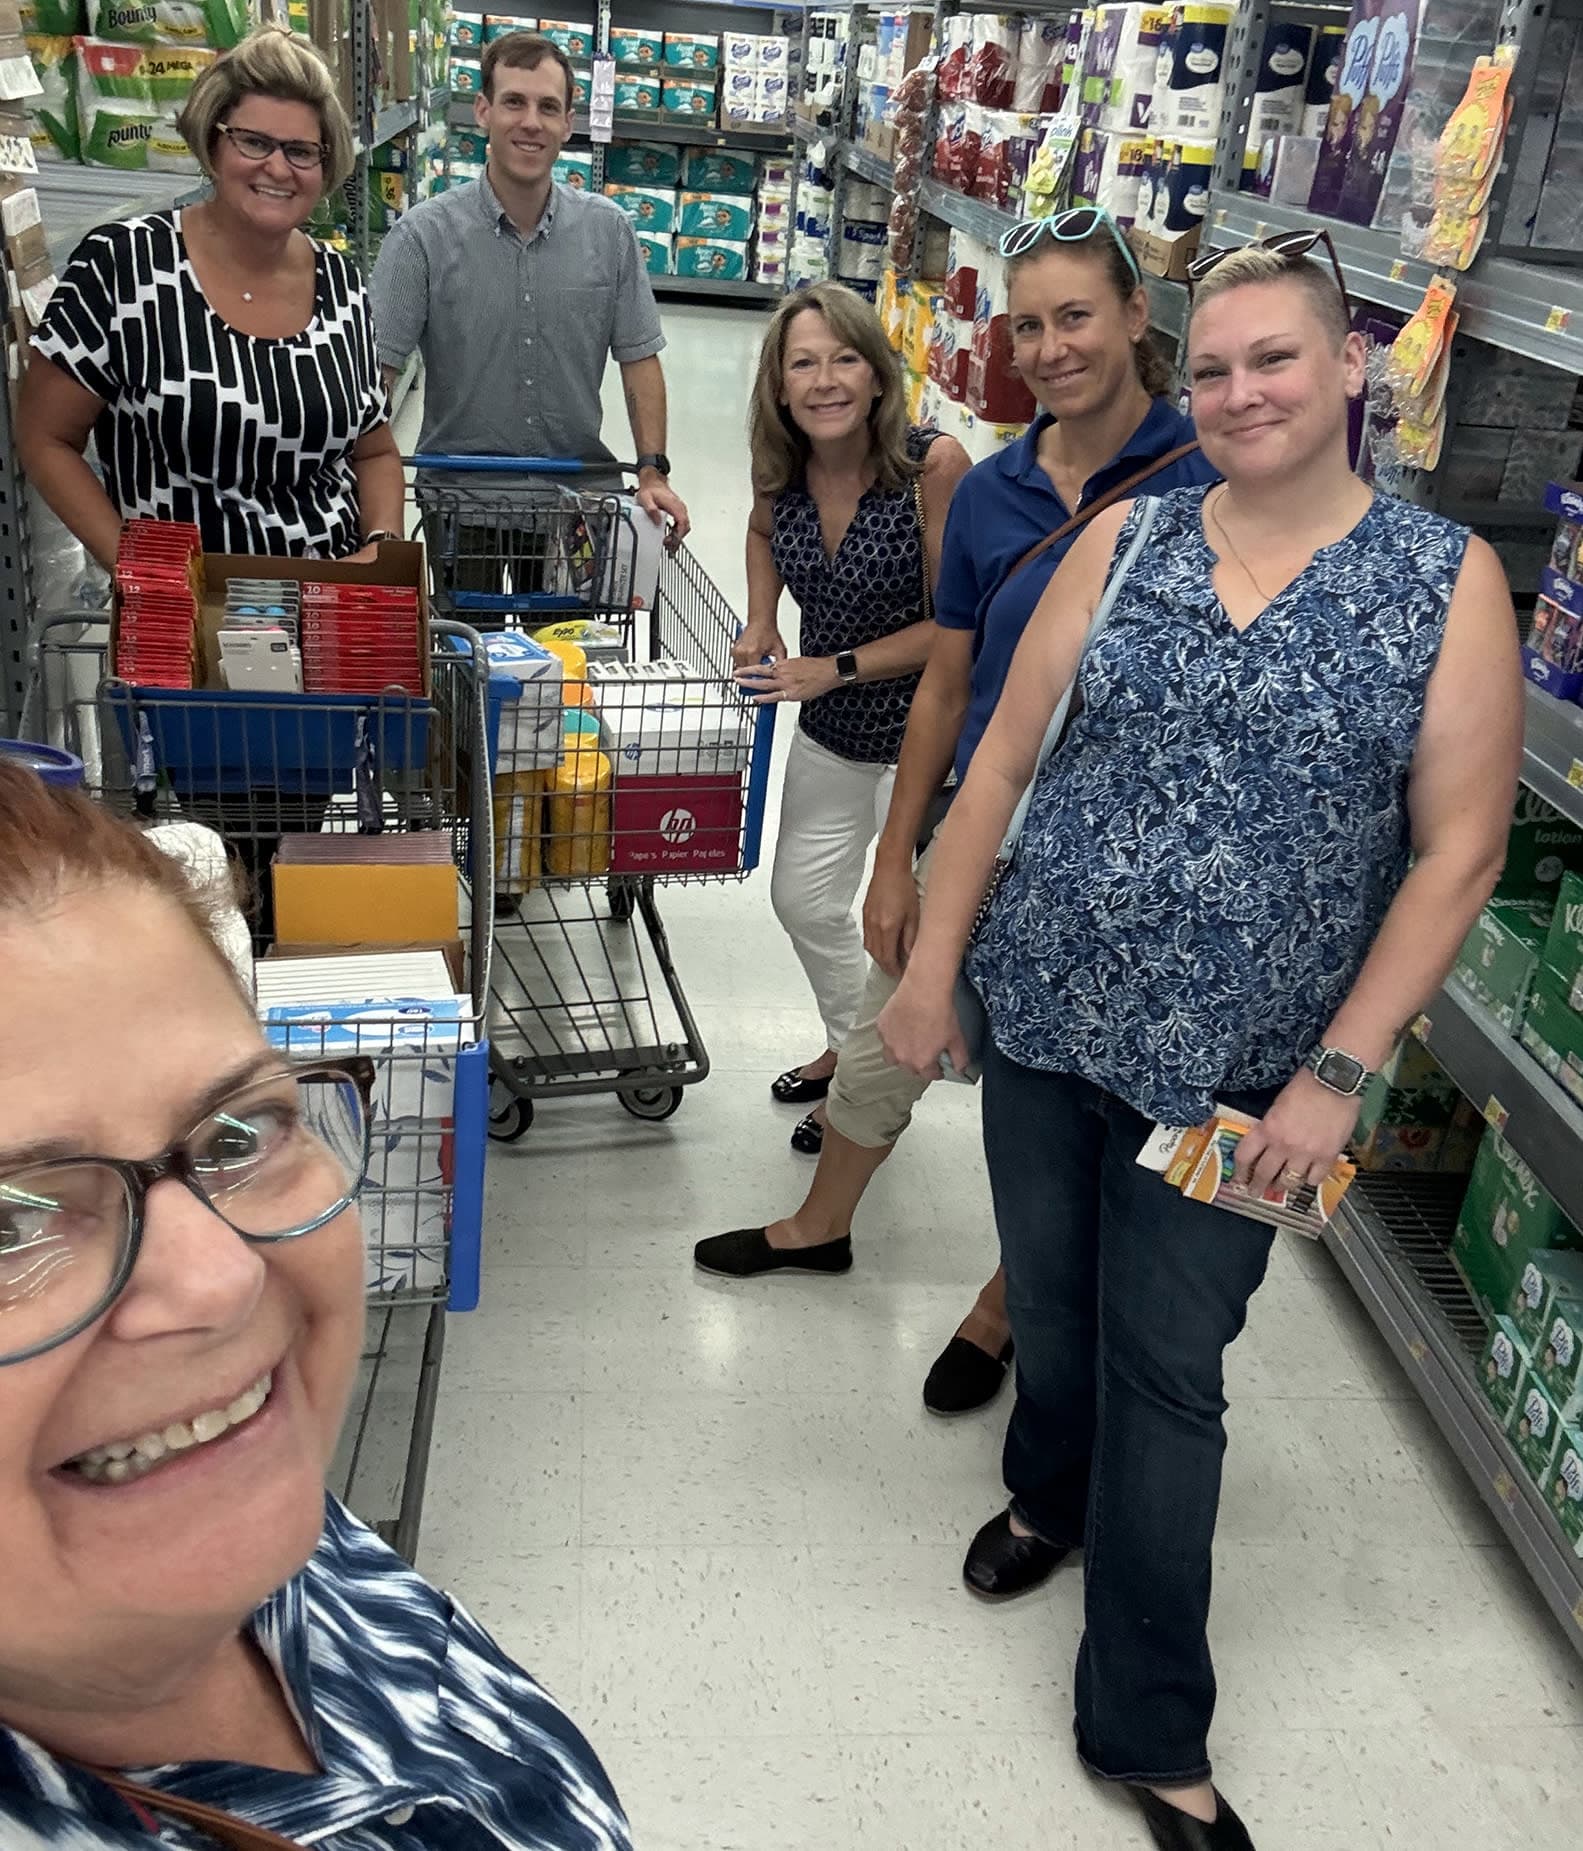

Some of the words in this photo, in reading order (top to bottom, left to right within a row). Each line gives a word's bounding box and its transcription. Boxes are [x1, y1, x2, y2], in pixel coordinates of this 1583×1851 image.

[108, 5, 157, 28] Bounty
[148, 61, 166, 76] 24
[128, 585, 141, 593] 12
[307, 585, 321, 594] 10
[660, 808, 696, 844] hp
